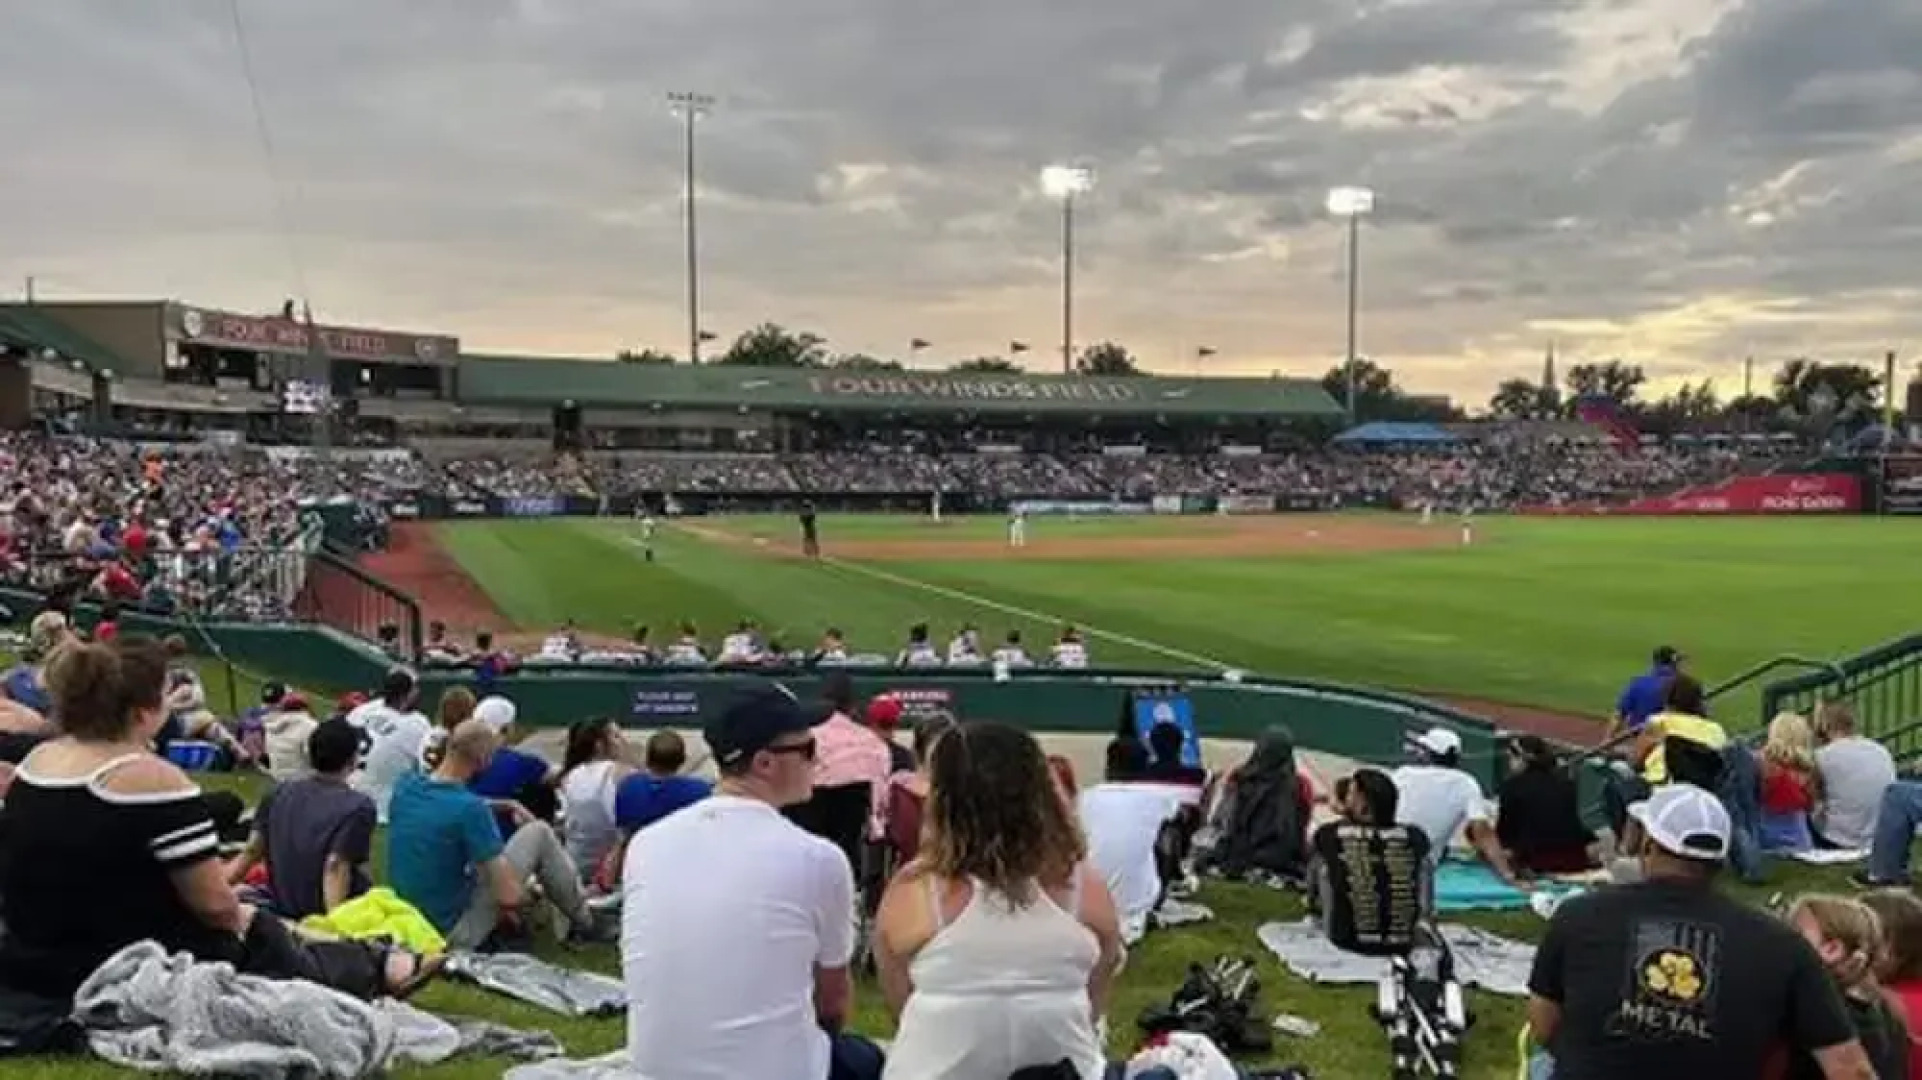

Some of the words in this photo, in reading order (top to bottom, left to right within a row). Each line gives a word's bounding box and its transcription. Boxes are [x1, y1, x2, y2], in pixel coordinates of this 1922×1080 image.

[808, 375, 911, 396] FOUR
[911, 378, 1035, 400] WINDS
[1038, 381, 1138, 400] FIELD
[1620, 999, 1713, 1040] METAL
